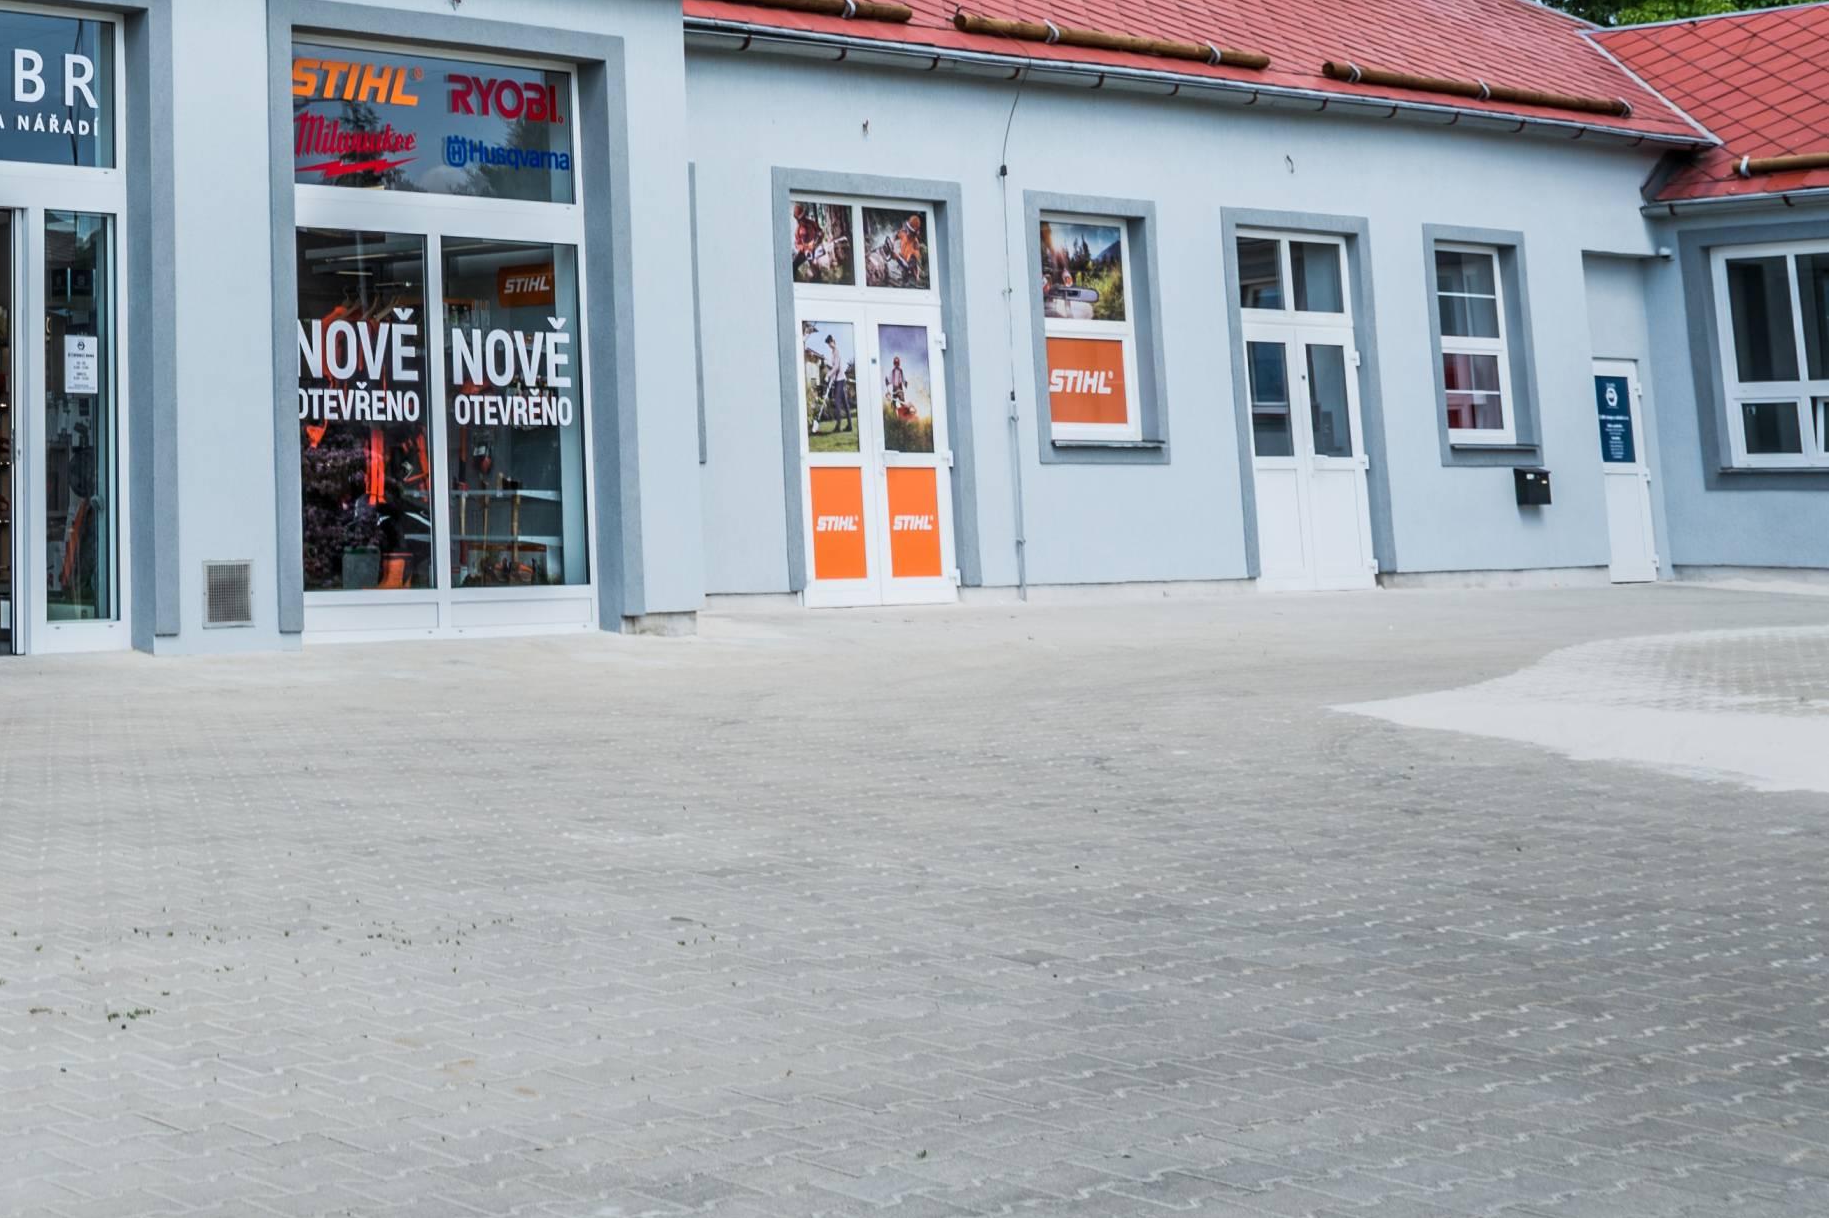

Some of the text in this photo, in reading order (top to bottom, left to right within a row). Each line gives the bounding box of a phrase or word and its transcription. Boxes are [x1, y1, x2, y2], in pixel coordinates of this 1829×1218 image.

[447, 74, 558, 123] RYOBI
[17, 112, 100, 137] NÁŘADÍ
[293, 110, 418, 158] Milwaukee
[468, 139, 571, 171] Husqvarna
[504, 275, 551, 295] STIHL
[297, 307, 420, 382] NOVĚ
[451, 316, 572, 388] NOVĚ
[1049, 368, 1113, 395] STIHL
[298, 381, 421, 422] OTEVŘENO
[816, 515, 858, 532] STIHL
[893, 514, 934, 531] STIHL
